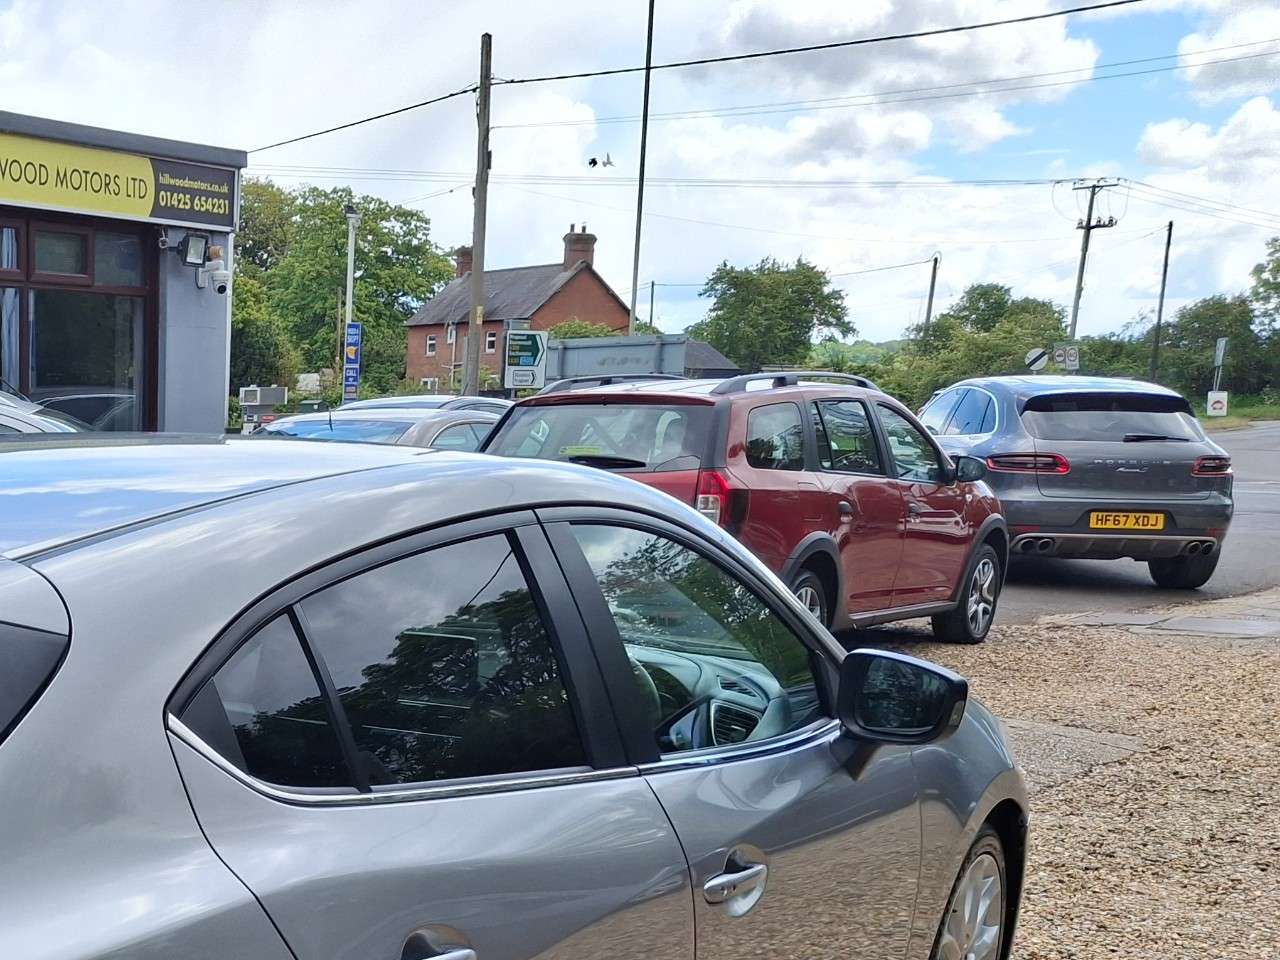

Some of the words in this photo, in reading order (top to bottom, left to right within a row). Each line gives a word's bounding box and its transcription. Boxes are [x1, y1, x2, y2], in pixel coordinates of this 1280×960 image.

[55, 164, 121, 197] MOTORS
[126, 175, 148, 199] LTD
[159, 171, 229, 193] hillwoodmotors.co.uk
[159, 190, 191, 210] 01425
[193, 195, 229, 215] 654231
[1095, 514, 1130, 527] HF67
[1132, 515, 1159, 527] XDJ
